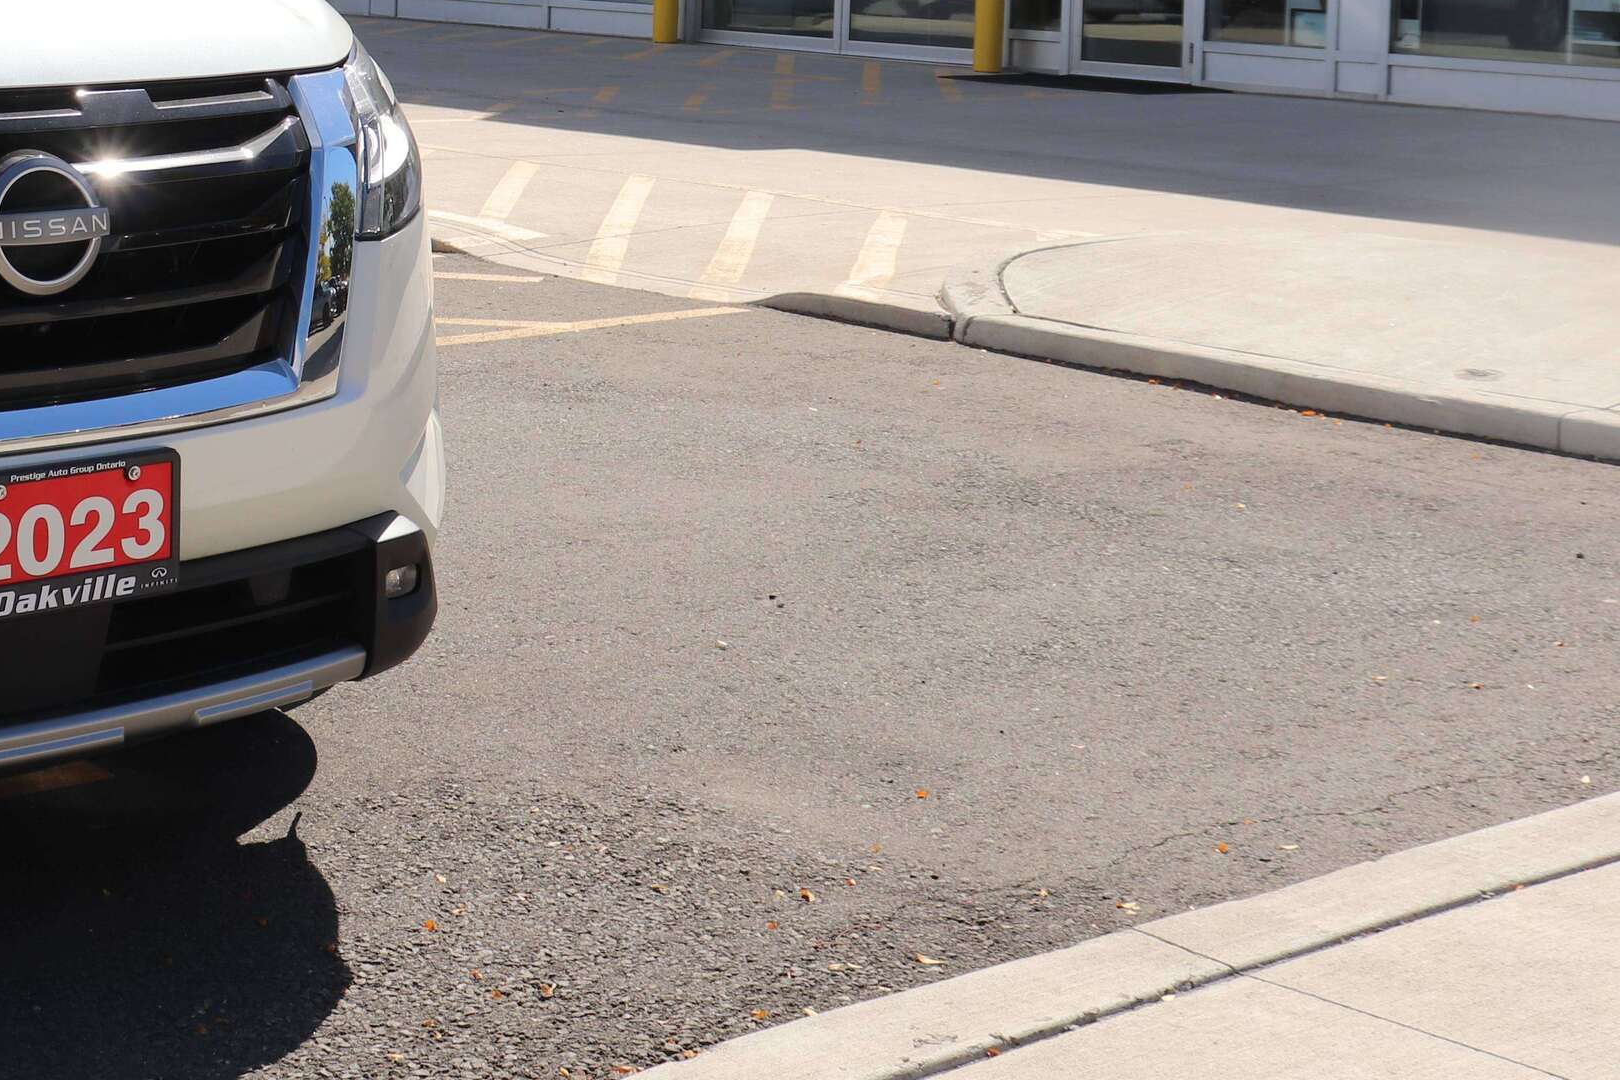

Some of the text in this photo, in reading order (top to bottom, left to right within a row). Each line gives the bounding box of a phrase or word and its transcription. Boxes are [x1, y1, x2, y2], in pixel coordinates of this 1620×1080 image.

[10, 460, 126, 483] Prestige Auto Group Ontario
